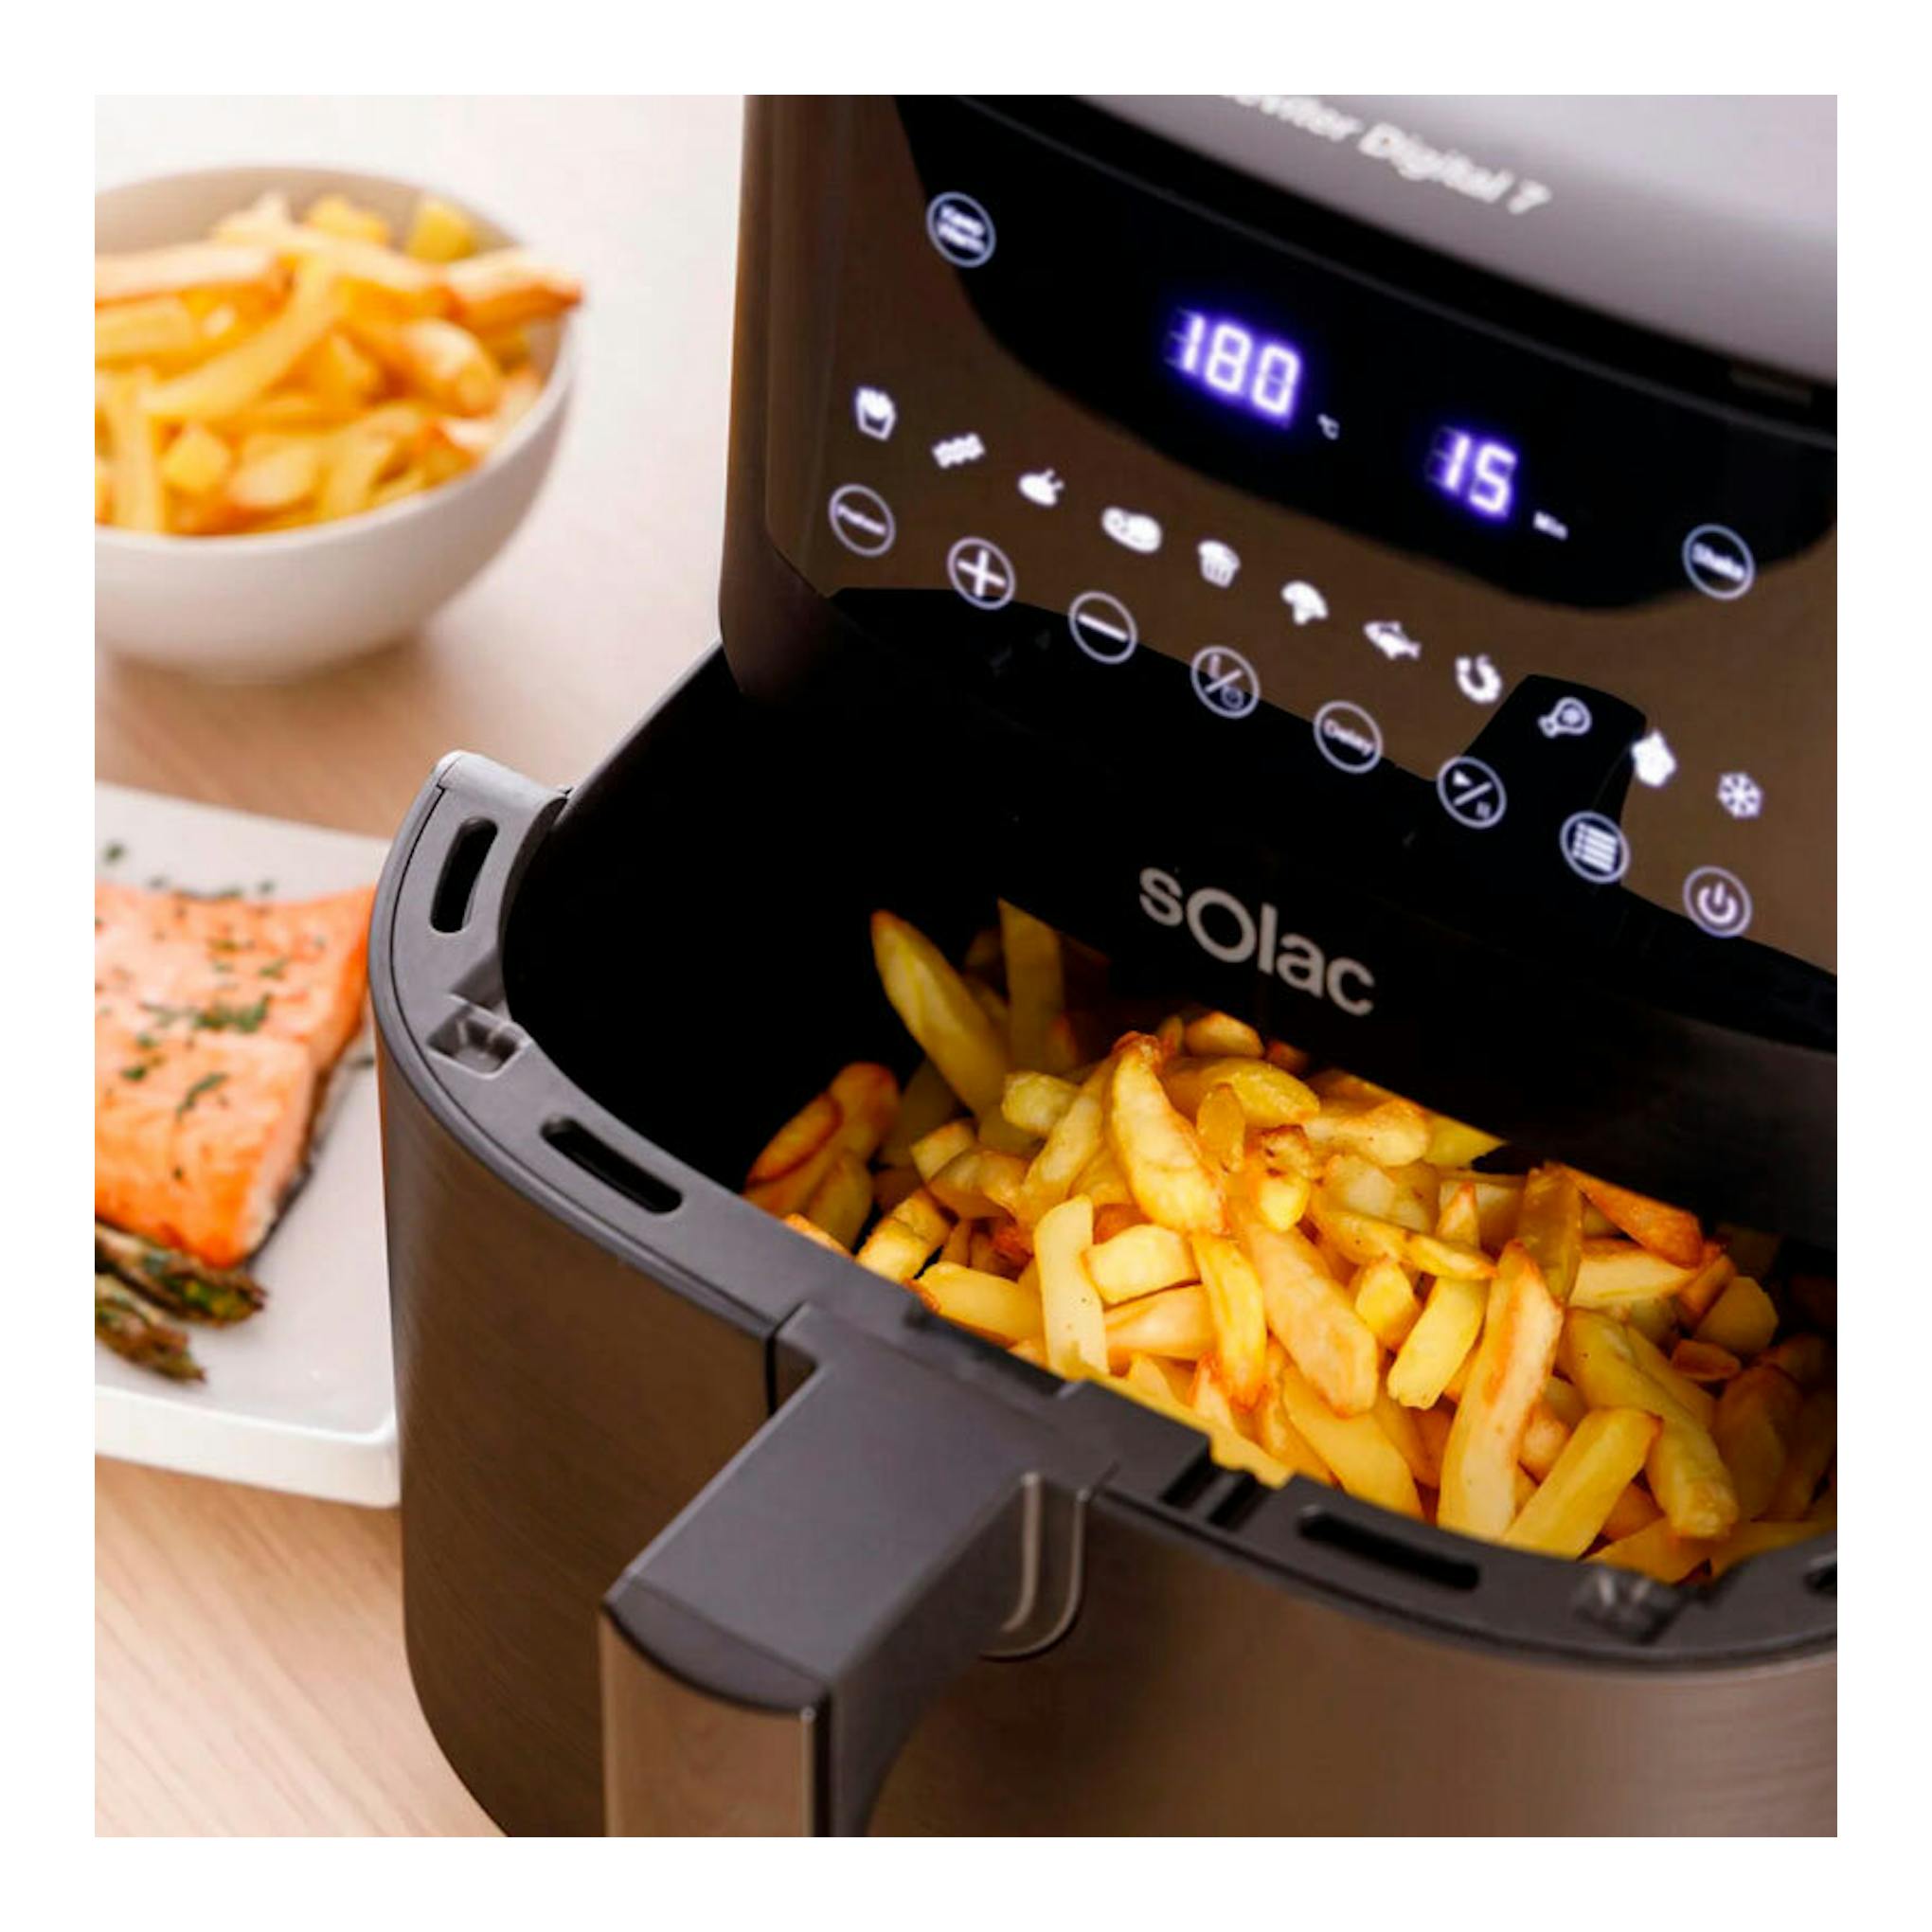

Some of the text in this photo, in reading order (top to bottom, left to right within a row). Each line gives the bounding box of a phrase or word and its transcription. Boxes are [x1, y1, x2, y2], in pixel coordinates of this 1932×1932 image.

[1357, 121, 1514, 203] Digital
[1178, 311, 1302, 419] 180
[1441, 429, 1517, 519] 15
